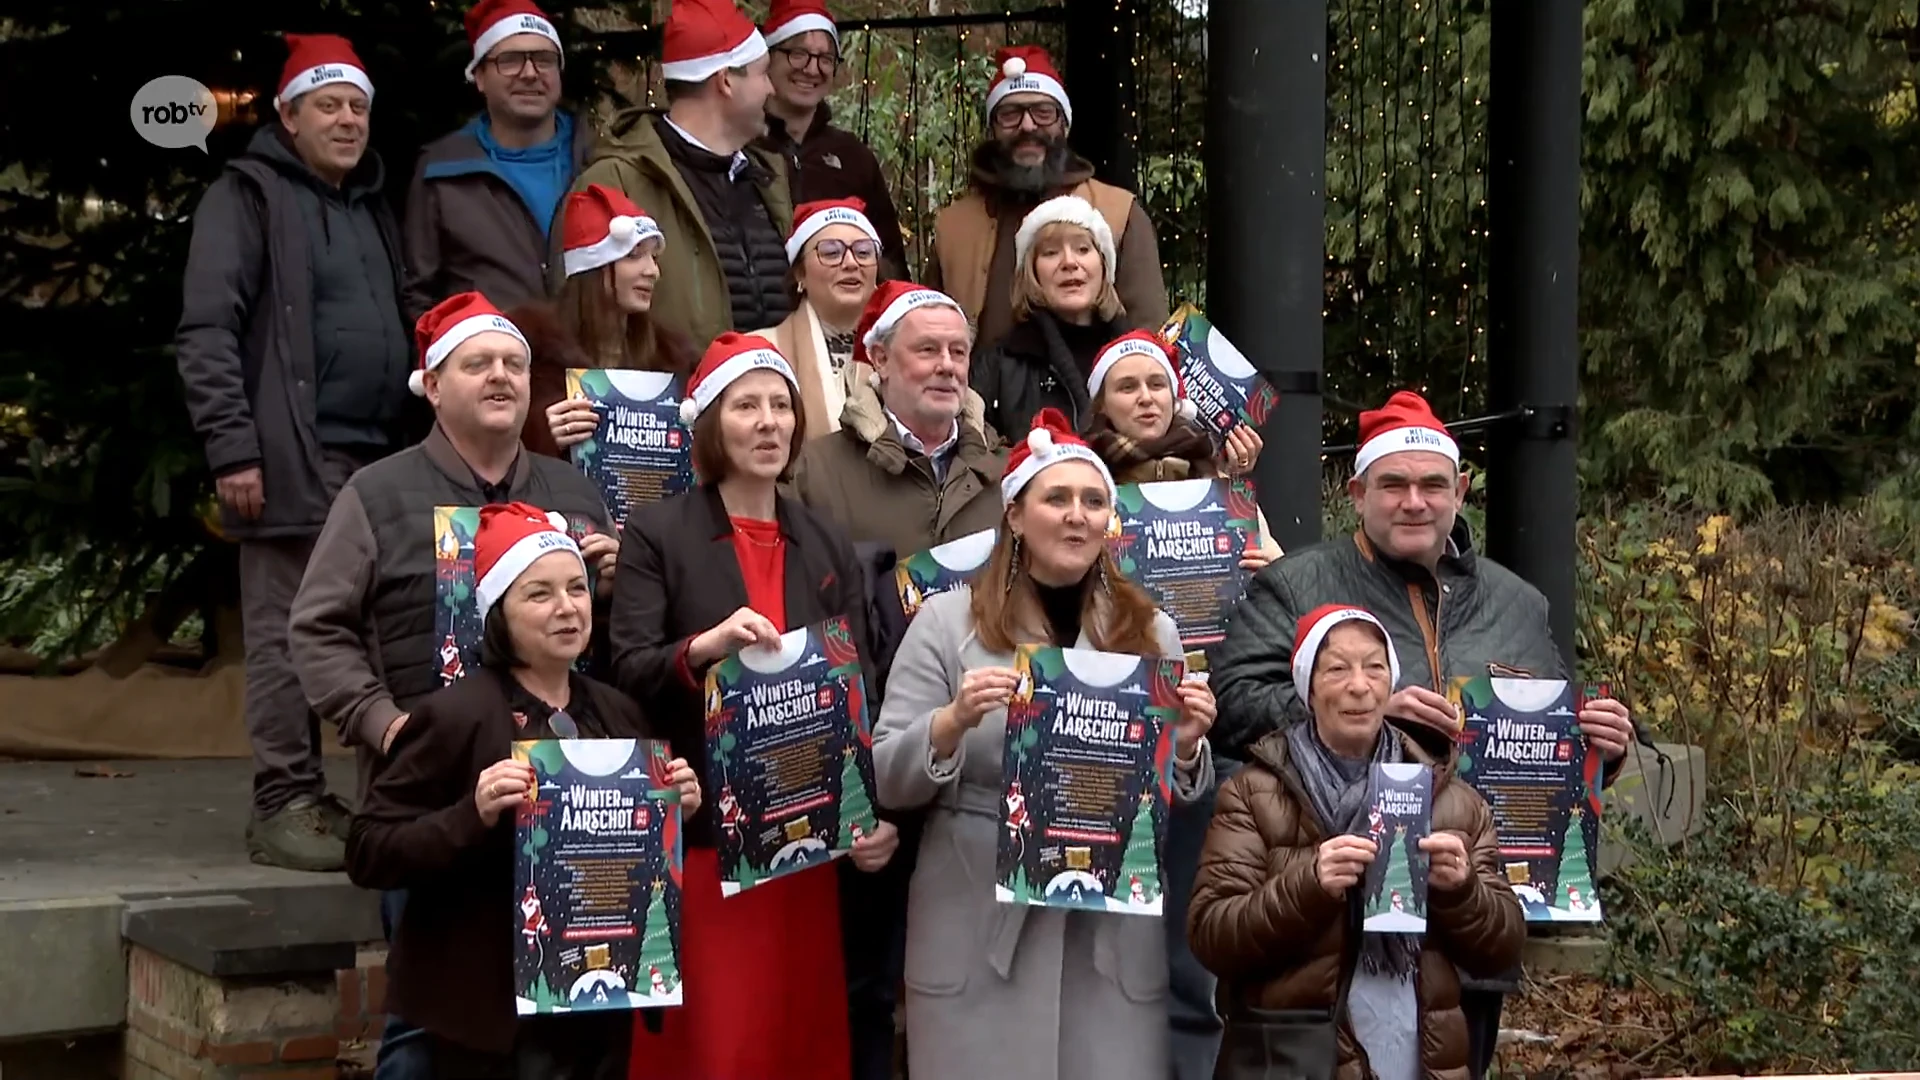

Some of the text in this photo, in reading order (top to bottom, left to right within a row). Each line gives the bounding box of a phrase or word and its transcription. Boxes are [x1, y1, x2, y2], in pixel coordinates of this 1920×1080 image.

[616, 405, 657, 429] WINTER
[605, 422, 667, 449] AARSCHOT
[1405, 434, 1441, 446] GASTHUIS
[1409, 428, 1423, 436] HET
[1152, 519, 1201, 540] WINTER
[1146, 536, 1215, 560] AARSCHOT
[752, 679, 802, 707] WINTER
[746, 692, 817, 731] AARSCHOT
[1066, 691, 1117, 720] WINTER
[1116, 710, 1130, 720] VAN
[1051, 709, 1128, 742] AARSCHOT
[1487, 723, 1496, 734] DE
[1496, 718, 1546, 740] WINTER
[1484, 735, 1557, 764] AARSCHOT
[570, 784, 621, 809] WINTER
[1384, 788, 1415, 802] WINTER
[560, 805, 634, 835] AARSCHOT
[1378, 798, 1423, 818] AARSCHOT
